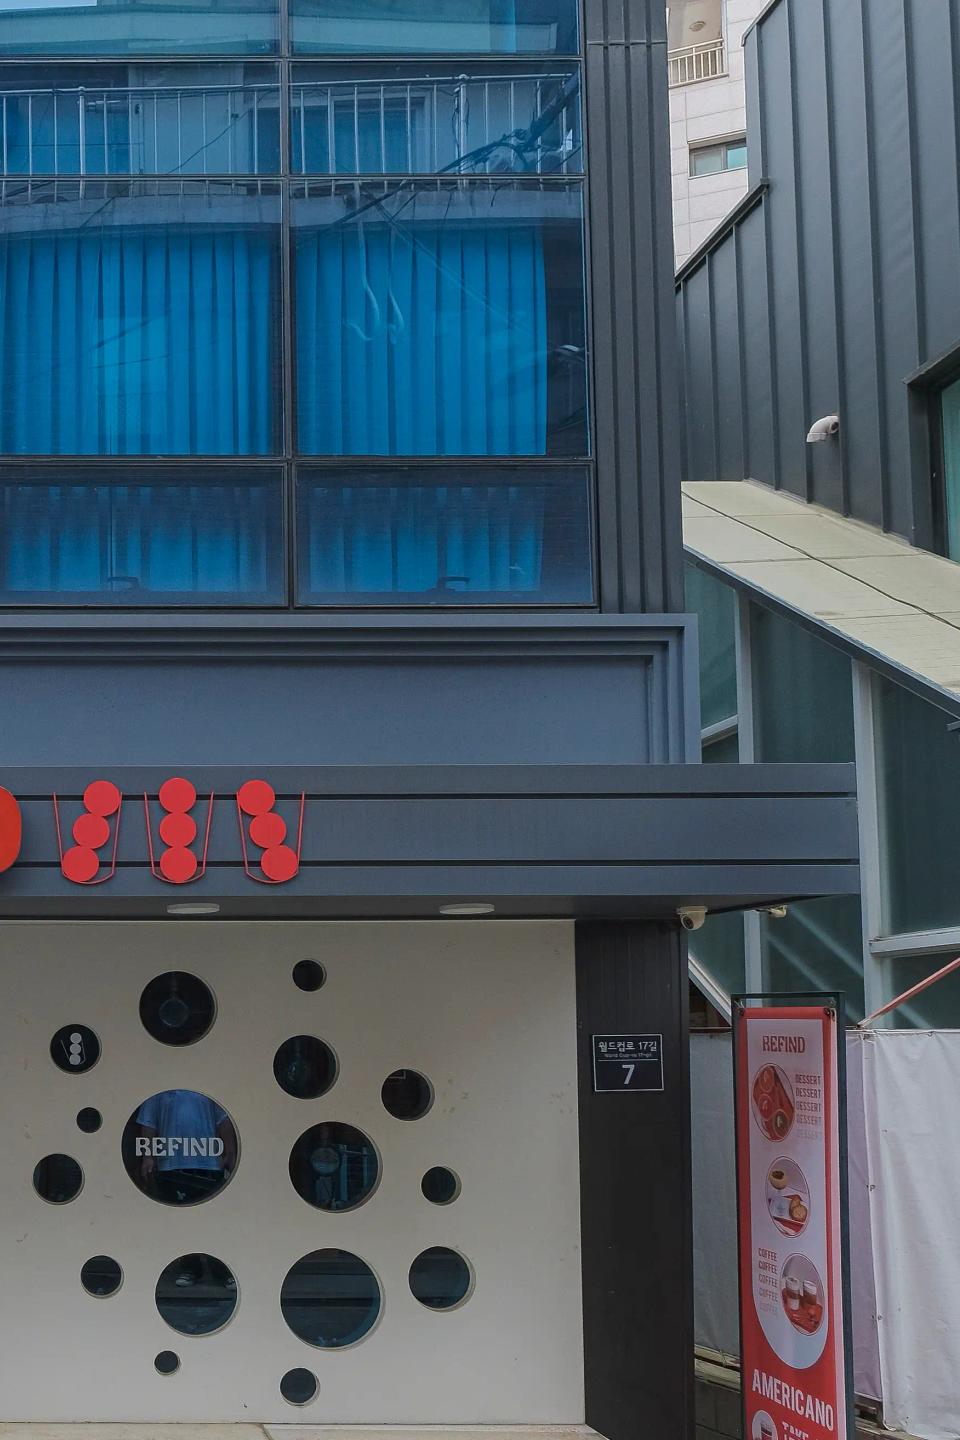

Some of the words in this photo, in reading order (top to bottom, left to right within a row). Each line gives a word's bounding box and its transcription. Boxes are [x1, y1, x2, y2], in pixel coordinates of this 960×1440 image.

[762, 1035, 806, 1054] REFIND
[622, 1064, 635, 1085] 7
[795, 1074, 821, 1085] DESSERT
[795, 1087, 821, 1099] DESSERT
[796, 1100, 822, 1112] DESSERT
[135, 1137, 224, 1157] REFIND
[758, 1247, 777, 1262] COFFEE
[758, 1261, 778, 1275] COFFEE
[759, 1273, 778, 1288] COFFEE
[751, 1368, 834, 1431] AMERICANO
